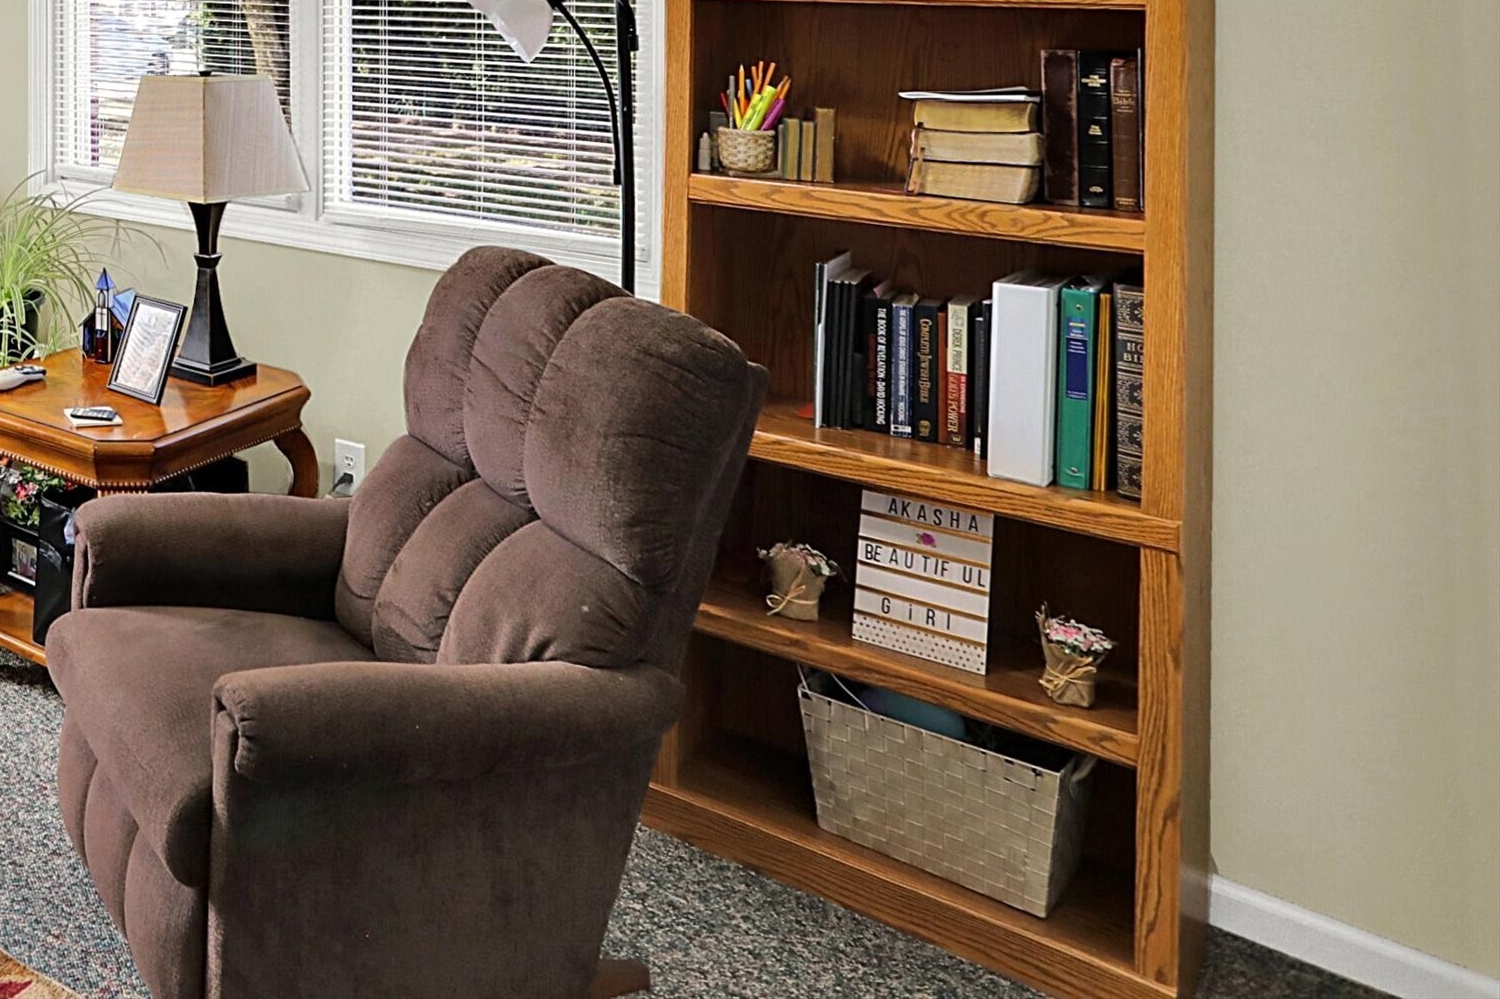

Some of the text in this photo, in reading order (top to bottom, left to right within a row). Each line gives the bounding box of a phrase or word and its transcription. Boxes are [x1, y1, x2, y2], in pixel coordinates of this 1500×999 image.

[877, 308, 887, 318] THE
[877, 319, 887, 335] BOOK
[877, 344, 886, 378] REVELATION
[951, 328, 964, 371] DEREK PRINCE
[876, 381, 886, 399] DAVID
[947, 374, 959, 432] GOD'S POWER
[876, 399, 885, 425] HOCKING
[888, 498, 979, 533] AKASHA
